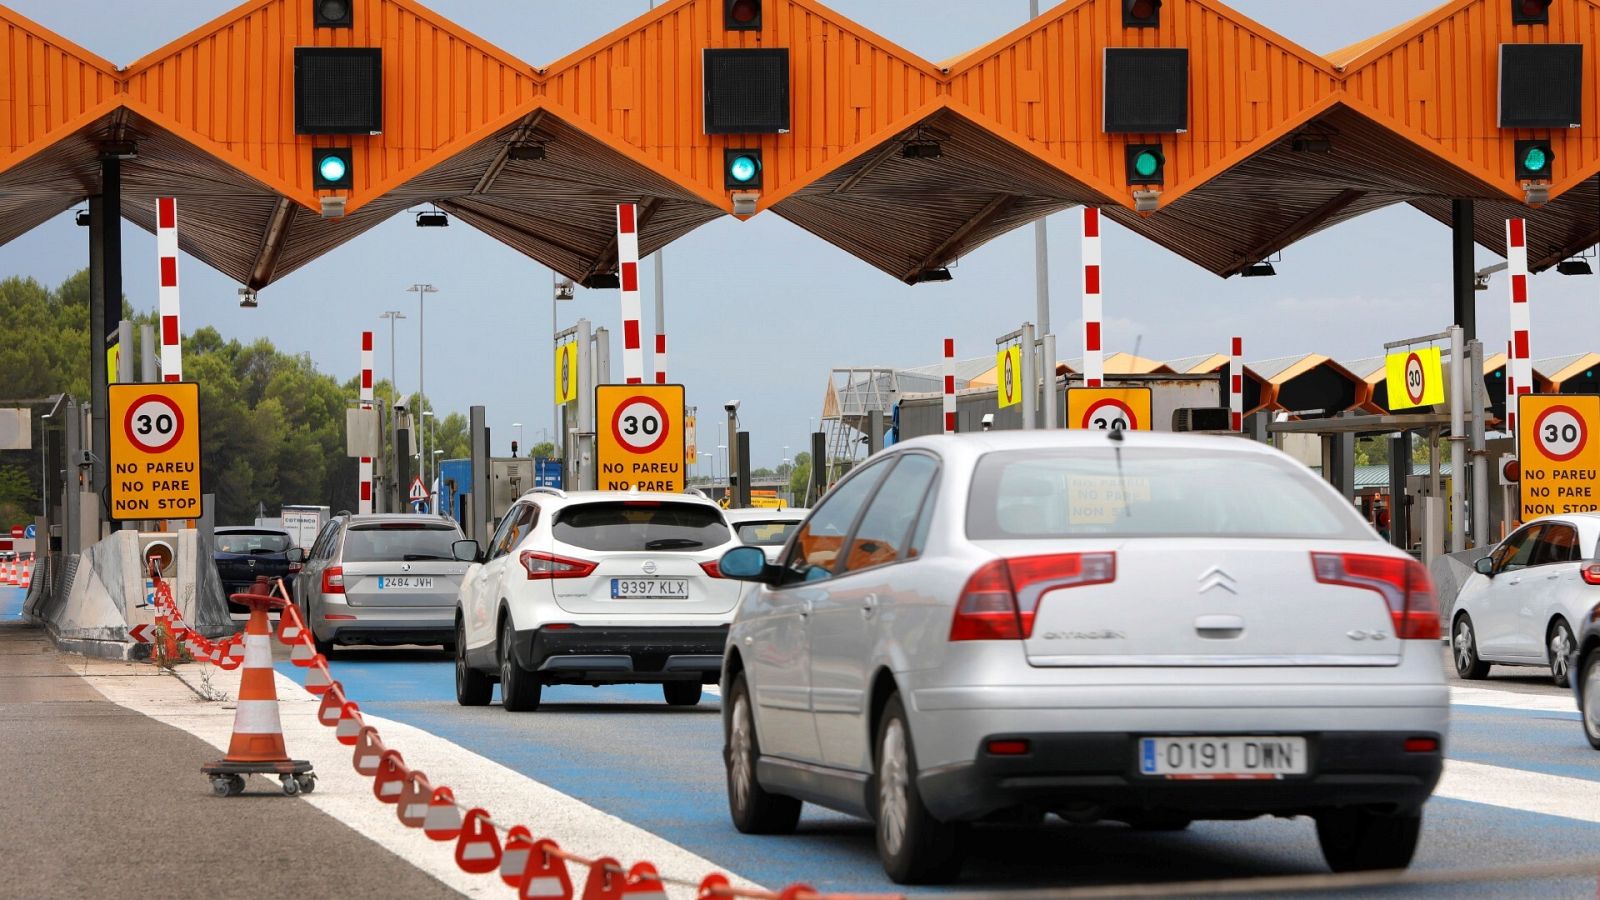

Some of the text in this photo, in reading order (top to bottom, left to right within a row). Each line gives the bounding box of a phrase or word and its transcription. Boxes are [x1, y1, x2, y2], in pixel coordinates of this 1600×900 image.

[1409, 369, 1421, 388] 30
[137, 414, 173, 435] 30
[623, 415, 658, 435] 30
[1544, 424, 1577, 443] 30
[116, 462, 194, 474] NO PAREU
[603, 463, 678, 474] NO PAREU
[1525, 469, 1596, 480] NO PAREU
[122, 480, 190, 492] NO PARE
[608, 480, 674, 491] NO PARE
[1530, 487, 1592, 497] NO PARE
[116, 498, 197, 510] NON STOP
[1525, 504, 1598, 514] NON STOP
[385, 577, 432, 587] 2484 JVH
[621, 581, 686, 594] 9397 KLX
[1167, 742, 1230, 769] 0191
